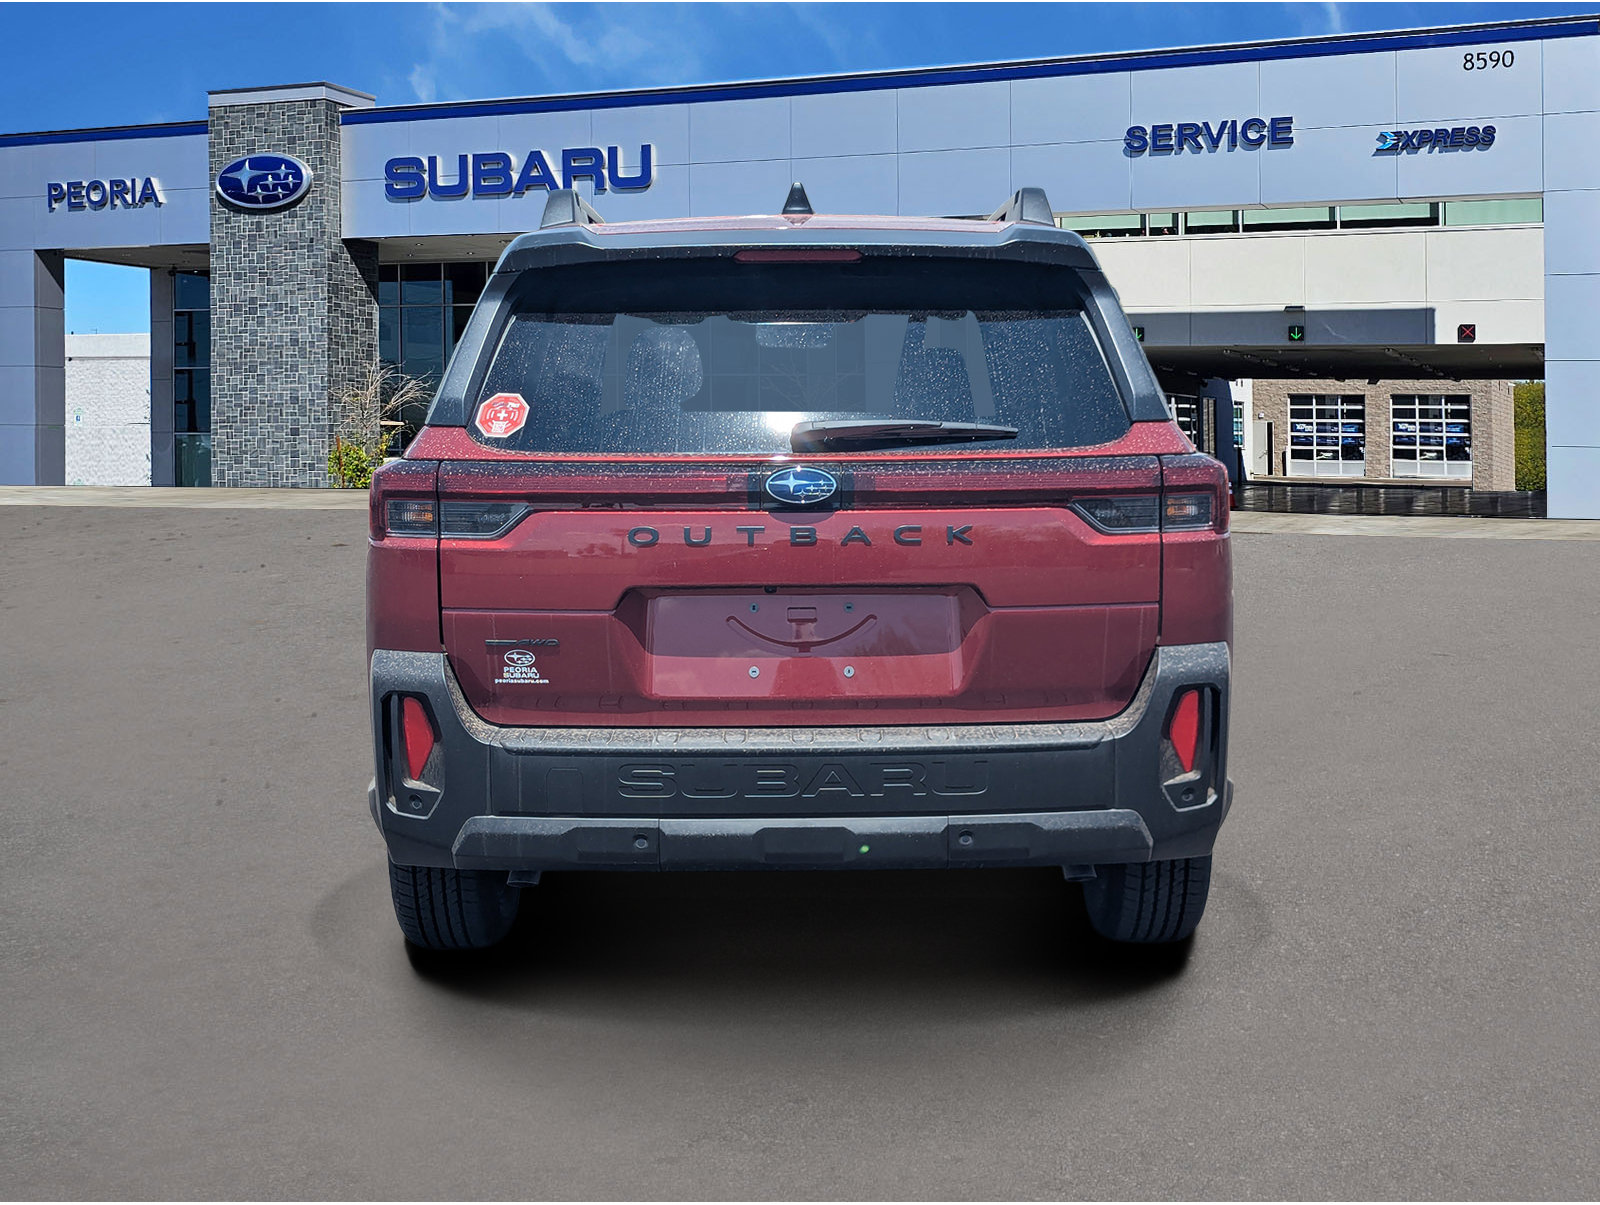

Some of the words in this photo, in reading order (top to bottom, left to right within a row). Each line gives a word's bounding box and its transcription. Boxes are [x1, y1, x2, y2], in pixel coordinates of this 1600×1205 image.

[1462, 50, 1515, 71] 8590
[1125, 116, 1294, 152] SERVICE
[1375, 125, 1497, 152] EXPRESS
[384, 144, 652, 199] SUBARU
[47, 177, 162, 211] PEORIA
[627, 524, 974, 547] OUTBACK
[617, 760, 990, 799] SUBARU
